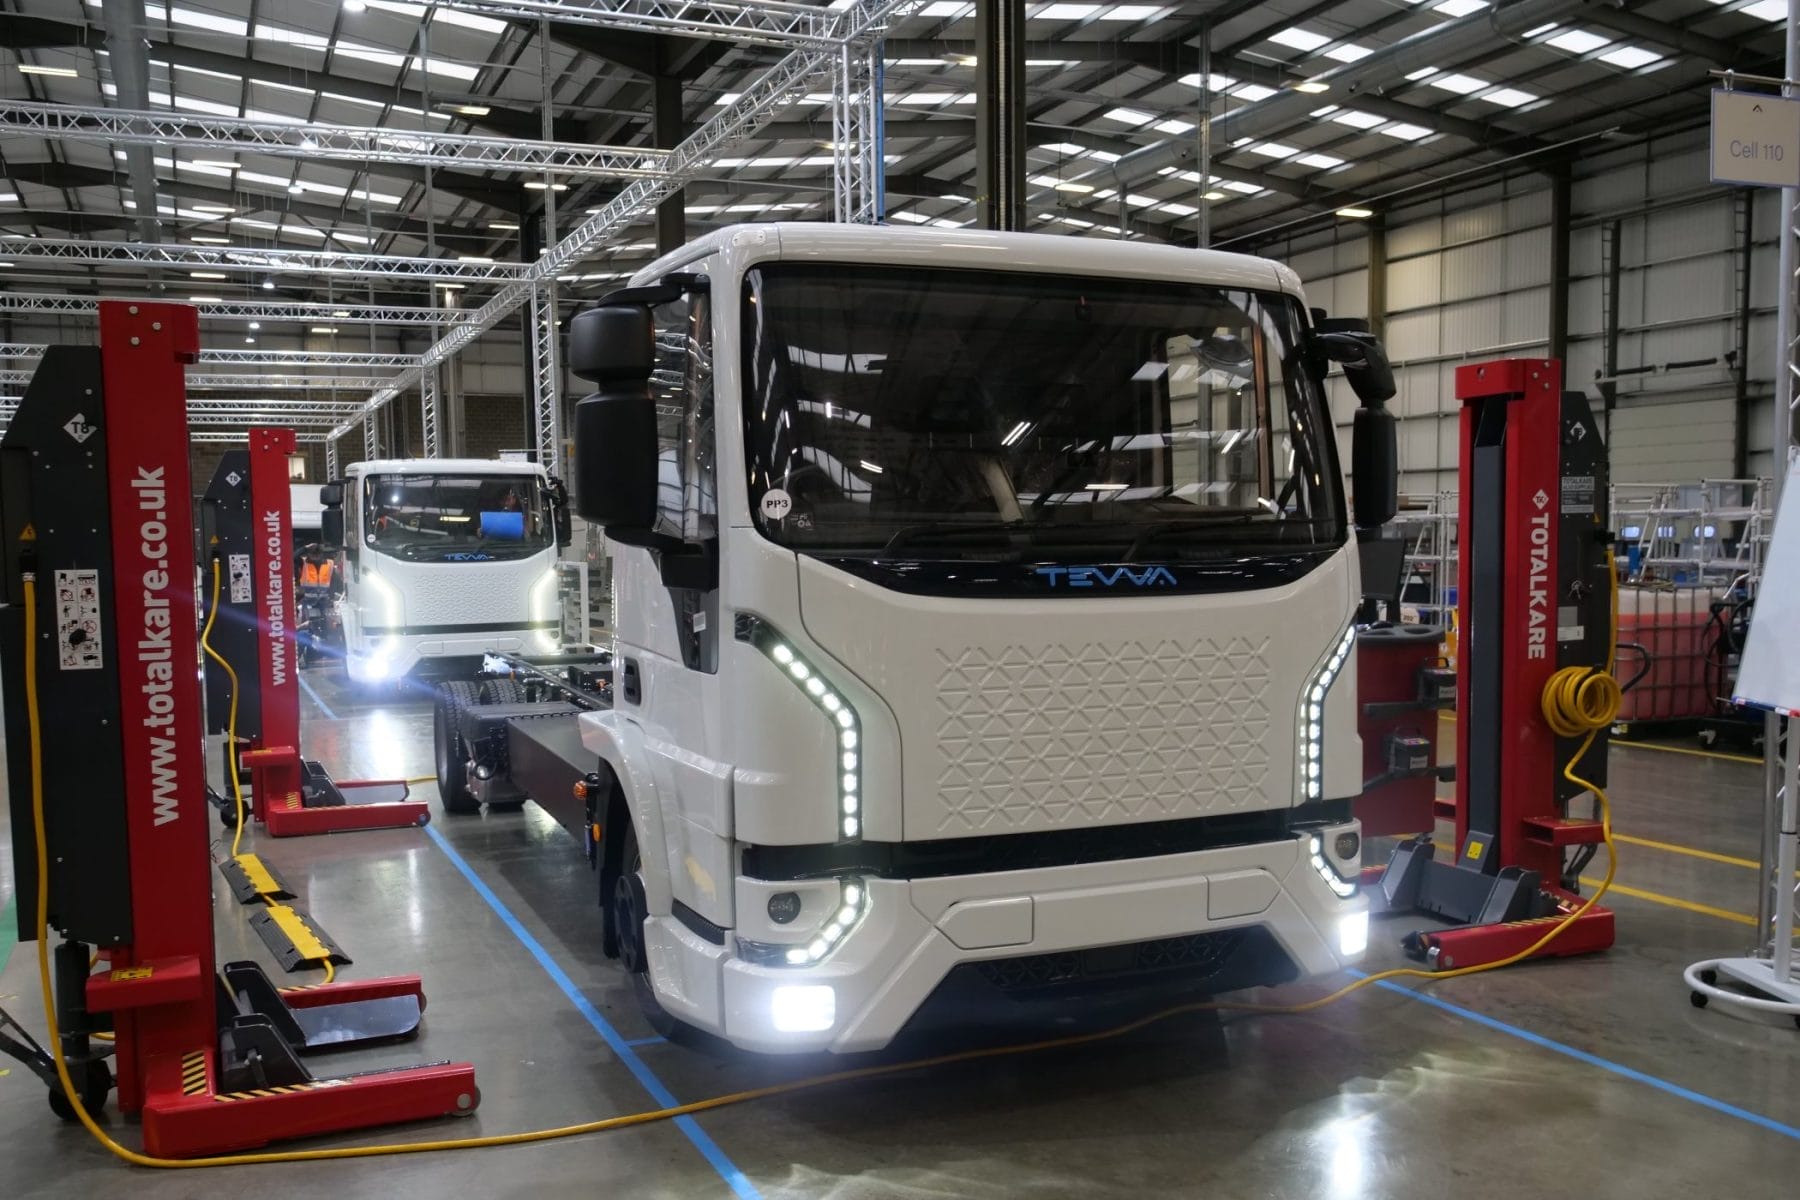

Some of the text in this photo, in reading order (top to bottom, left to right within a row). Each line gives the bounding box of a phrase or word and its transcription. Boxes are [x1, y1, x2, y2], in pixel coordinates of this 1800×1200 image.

[1730, 140, 1784, 162] Cell 110
[71, 421, 89, 434] T8
[766, 499, 788, 509] PP3
[1035, 566, 1178, 588] TEVVA
[1527, 512, 1549, 660] TOTALKARE
[263, 510, 287, 686] www.totalkare.co.uk
[131, 465, 180, 827] www.totalkare.co.uk
